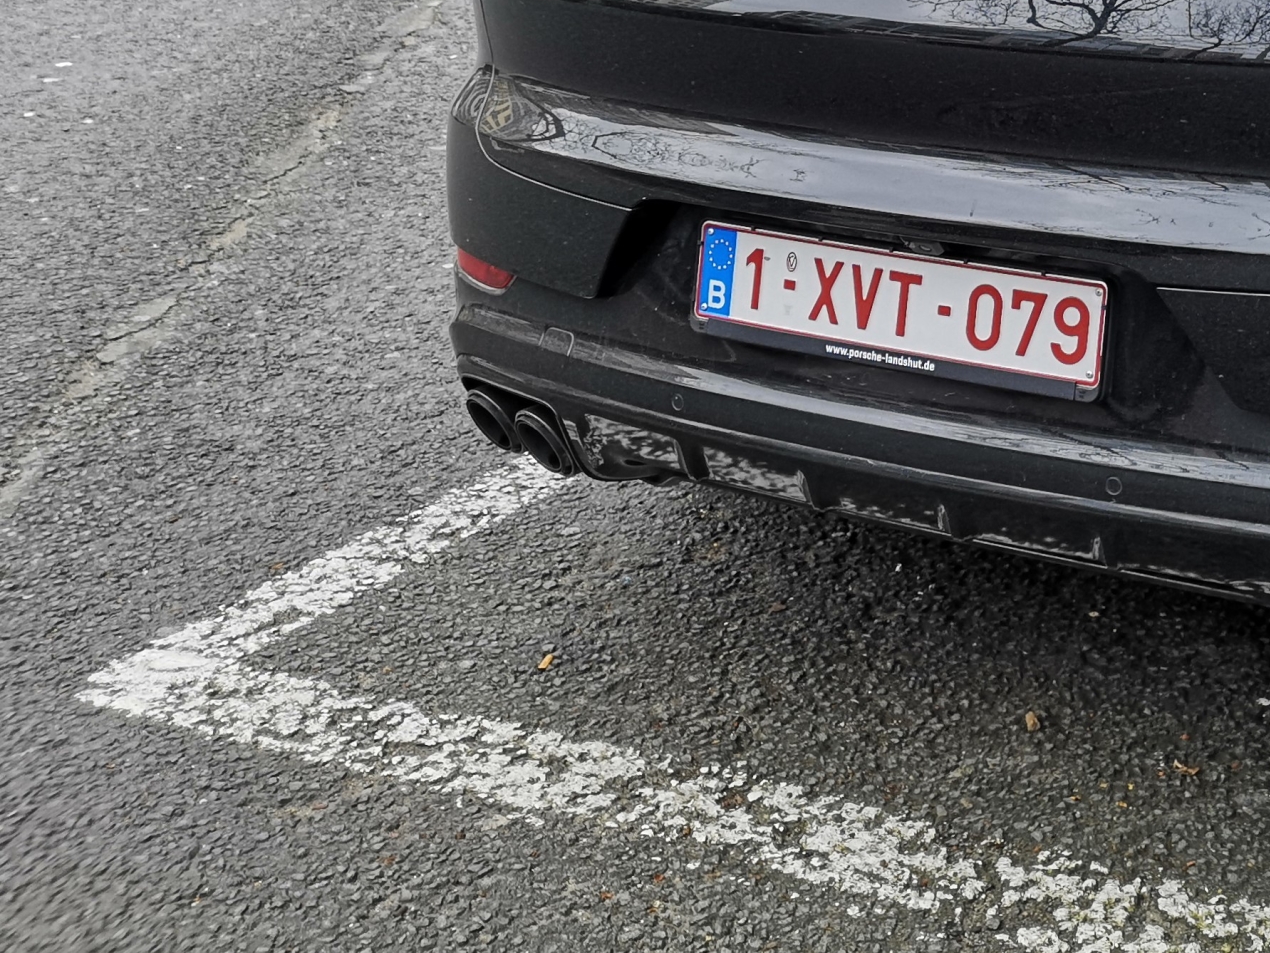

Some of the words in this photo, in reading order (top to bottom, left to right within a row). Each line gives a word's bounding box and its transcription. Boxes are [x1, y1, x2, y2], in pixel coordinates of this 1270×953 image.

[707, 279, 726, 309] B
[745, 248, 1091, 365] 1-XVT-079
[825, 344, 935, 372] www.porsche-landshut.de
